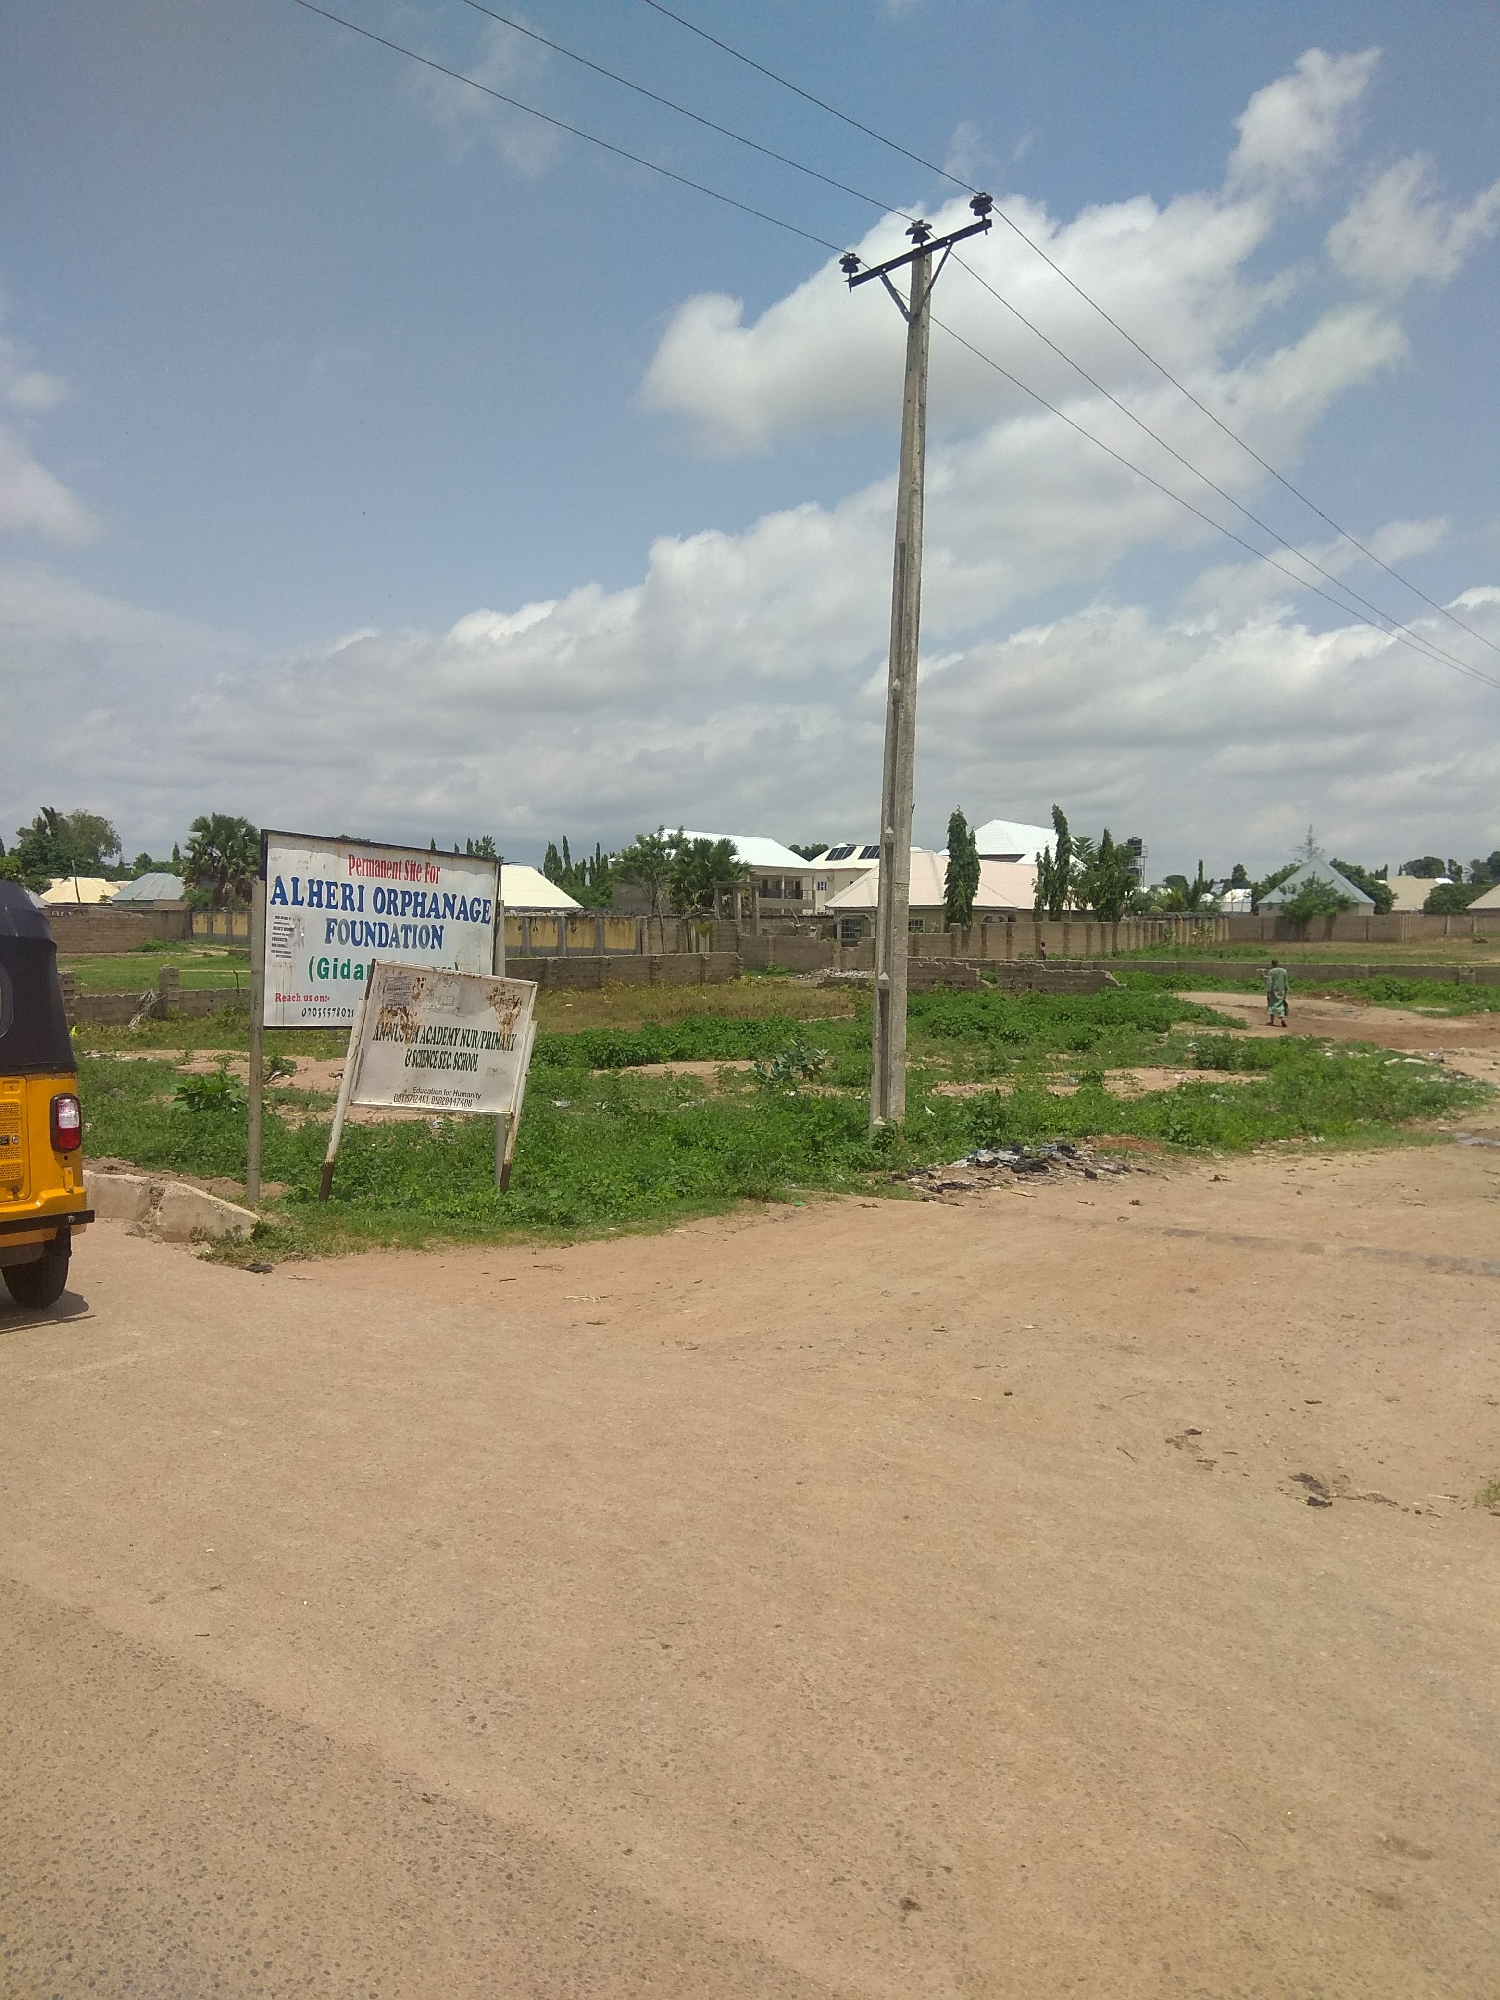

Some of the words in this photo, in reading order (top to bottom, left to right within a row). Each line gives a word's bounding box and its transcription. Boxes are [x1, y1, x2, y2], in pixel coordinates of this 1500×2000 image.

[348, 853, 402, 881] Permanent
[404, 860, 422, 882] Site
[424, 862, 441, 885] For
[270, 875, 365, 913] ALHERI
[373, 886, 492, 925] ORPHANAGE
[325, 917, 445, 950] FOUNDATION
[275, 992, 301, 1003] Reach
[303, 994, 313, 1003] us
[420, 1024, 461, 1047] ACADEMY
[411, 1049, 439, 1069] SCIENCE
[453, 1052, 479, 1072] SCHOOL
[413, 1086, 443, 1096] Education
[443, 1088, 452, 1096] for
[452, 1089, 482, 1101] Humanity
